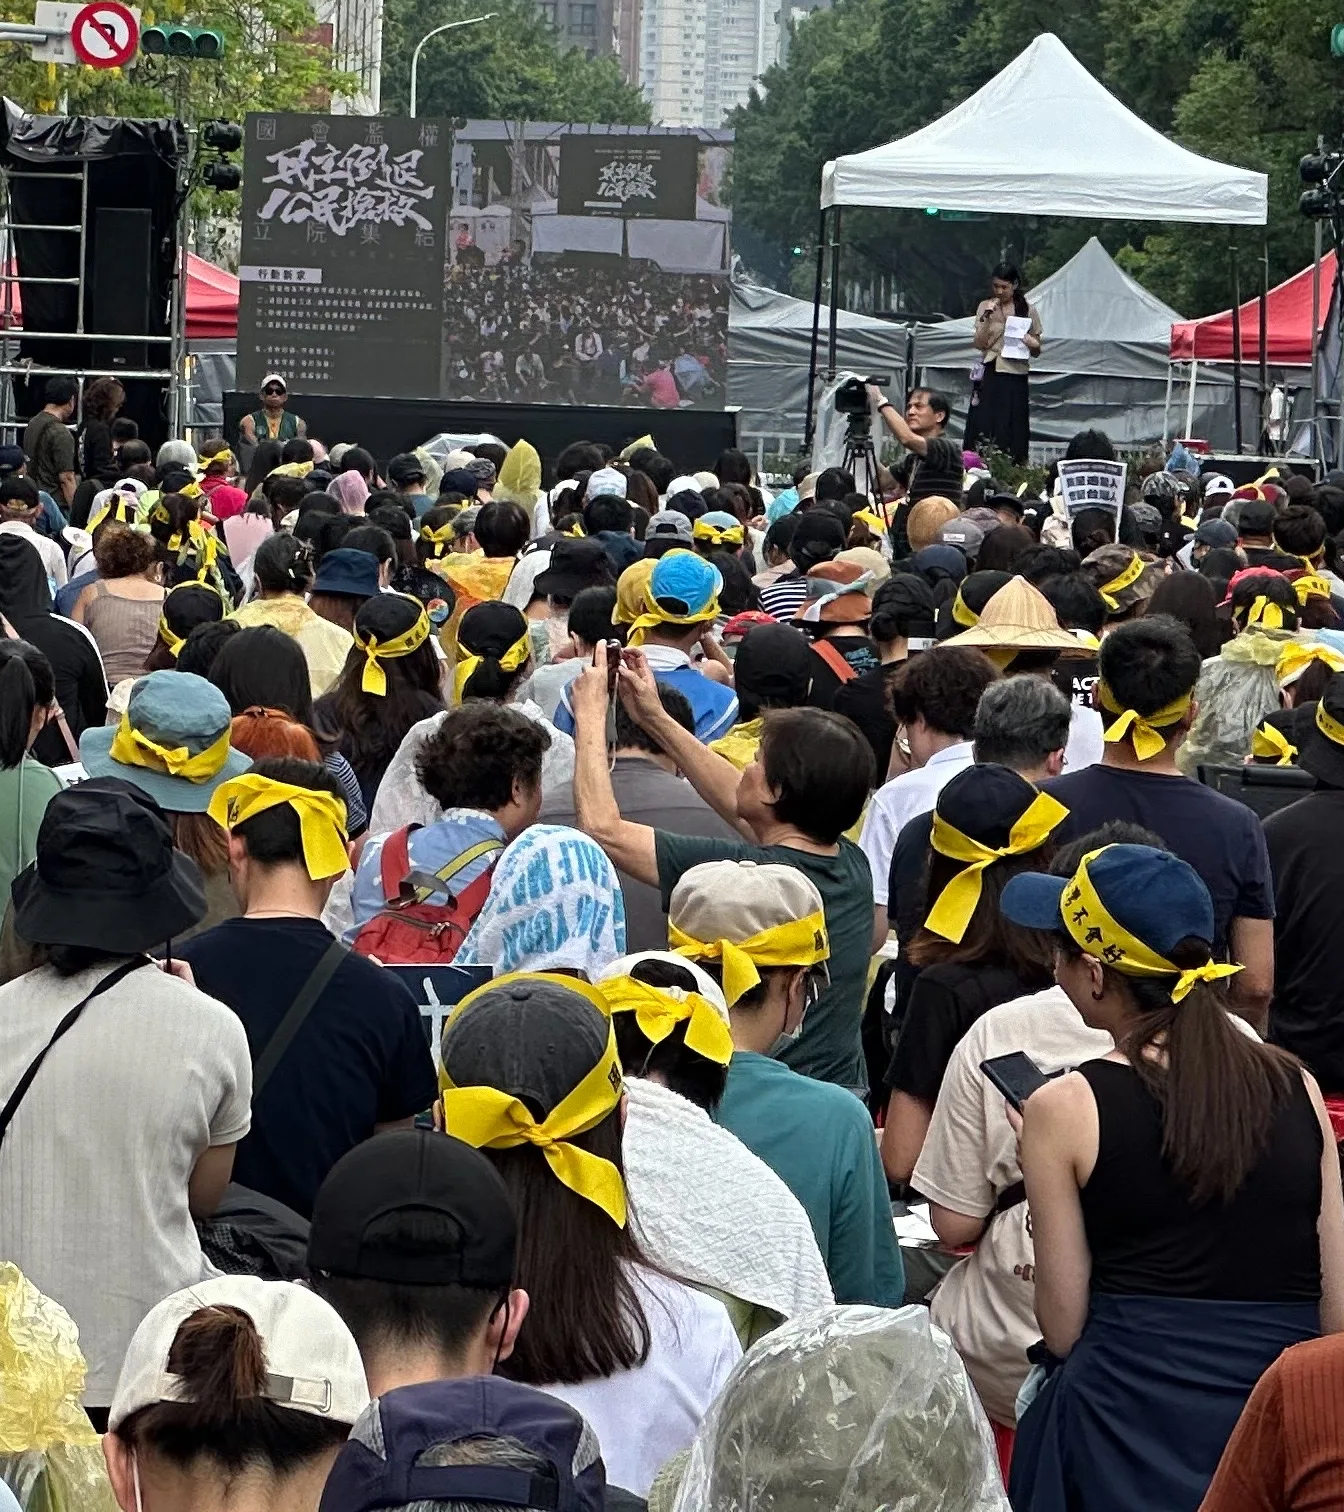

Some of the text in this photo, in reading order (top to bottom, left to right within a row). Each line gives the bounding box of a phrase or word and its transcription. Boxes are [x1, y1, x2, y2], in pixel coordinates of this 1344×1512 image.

[256, 118, 439, 148] 國會濫權
[262, 138, 436, 200] 民主倒退
[253, 219, 436, 248] 立院集結
[258, 268, 306, 281] 行動訴求
